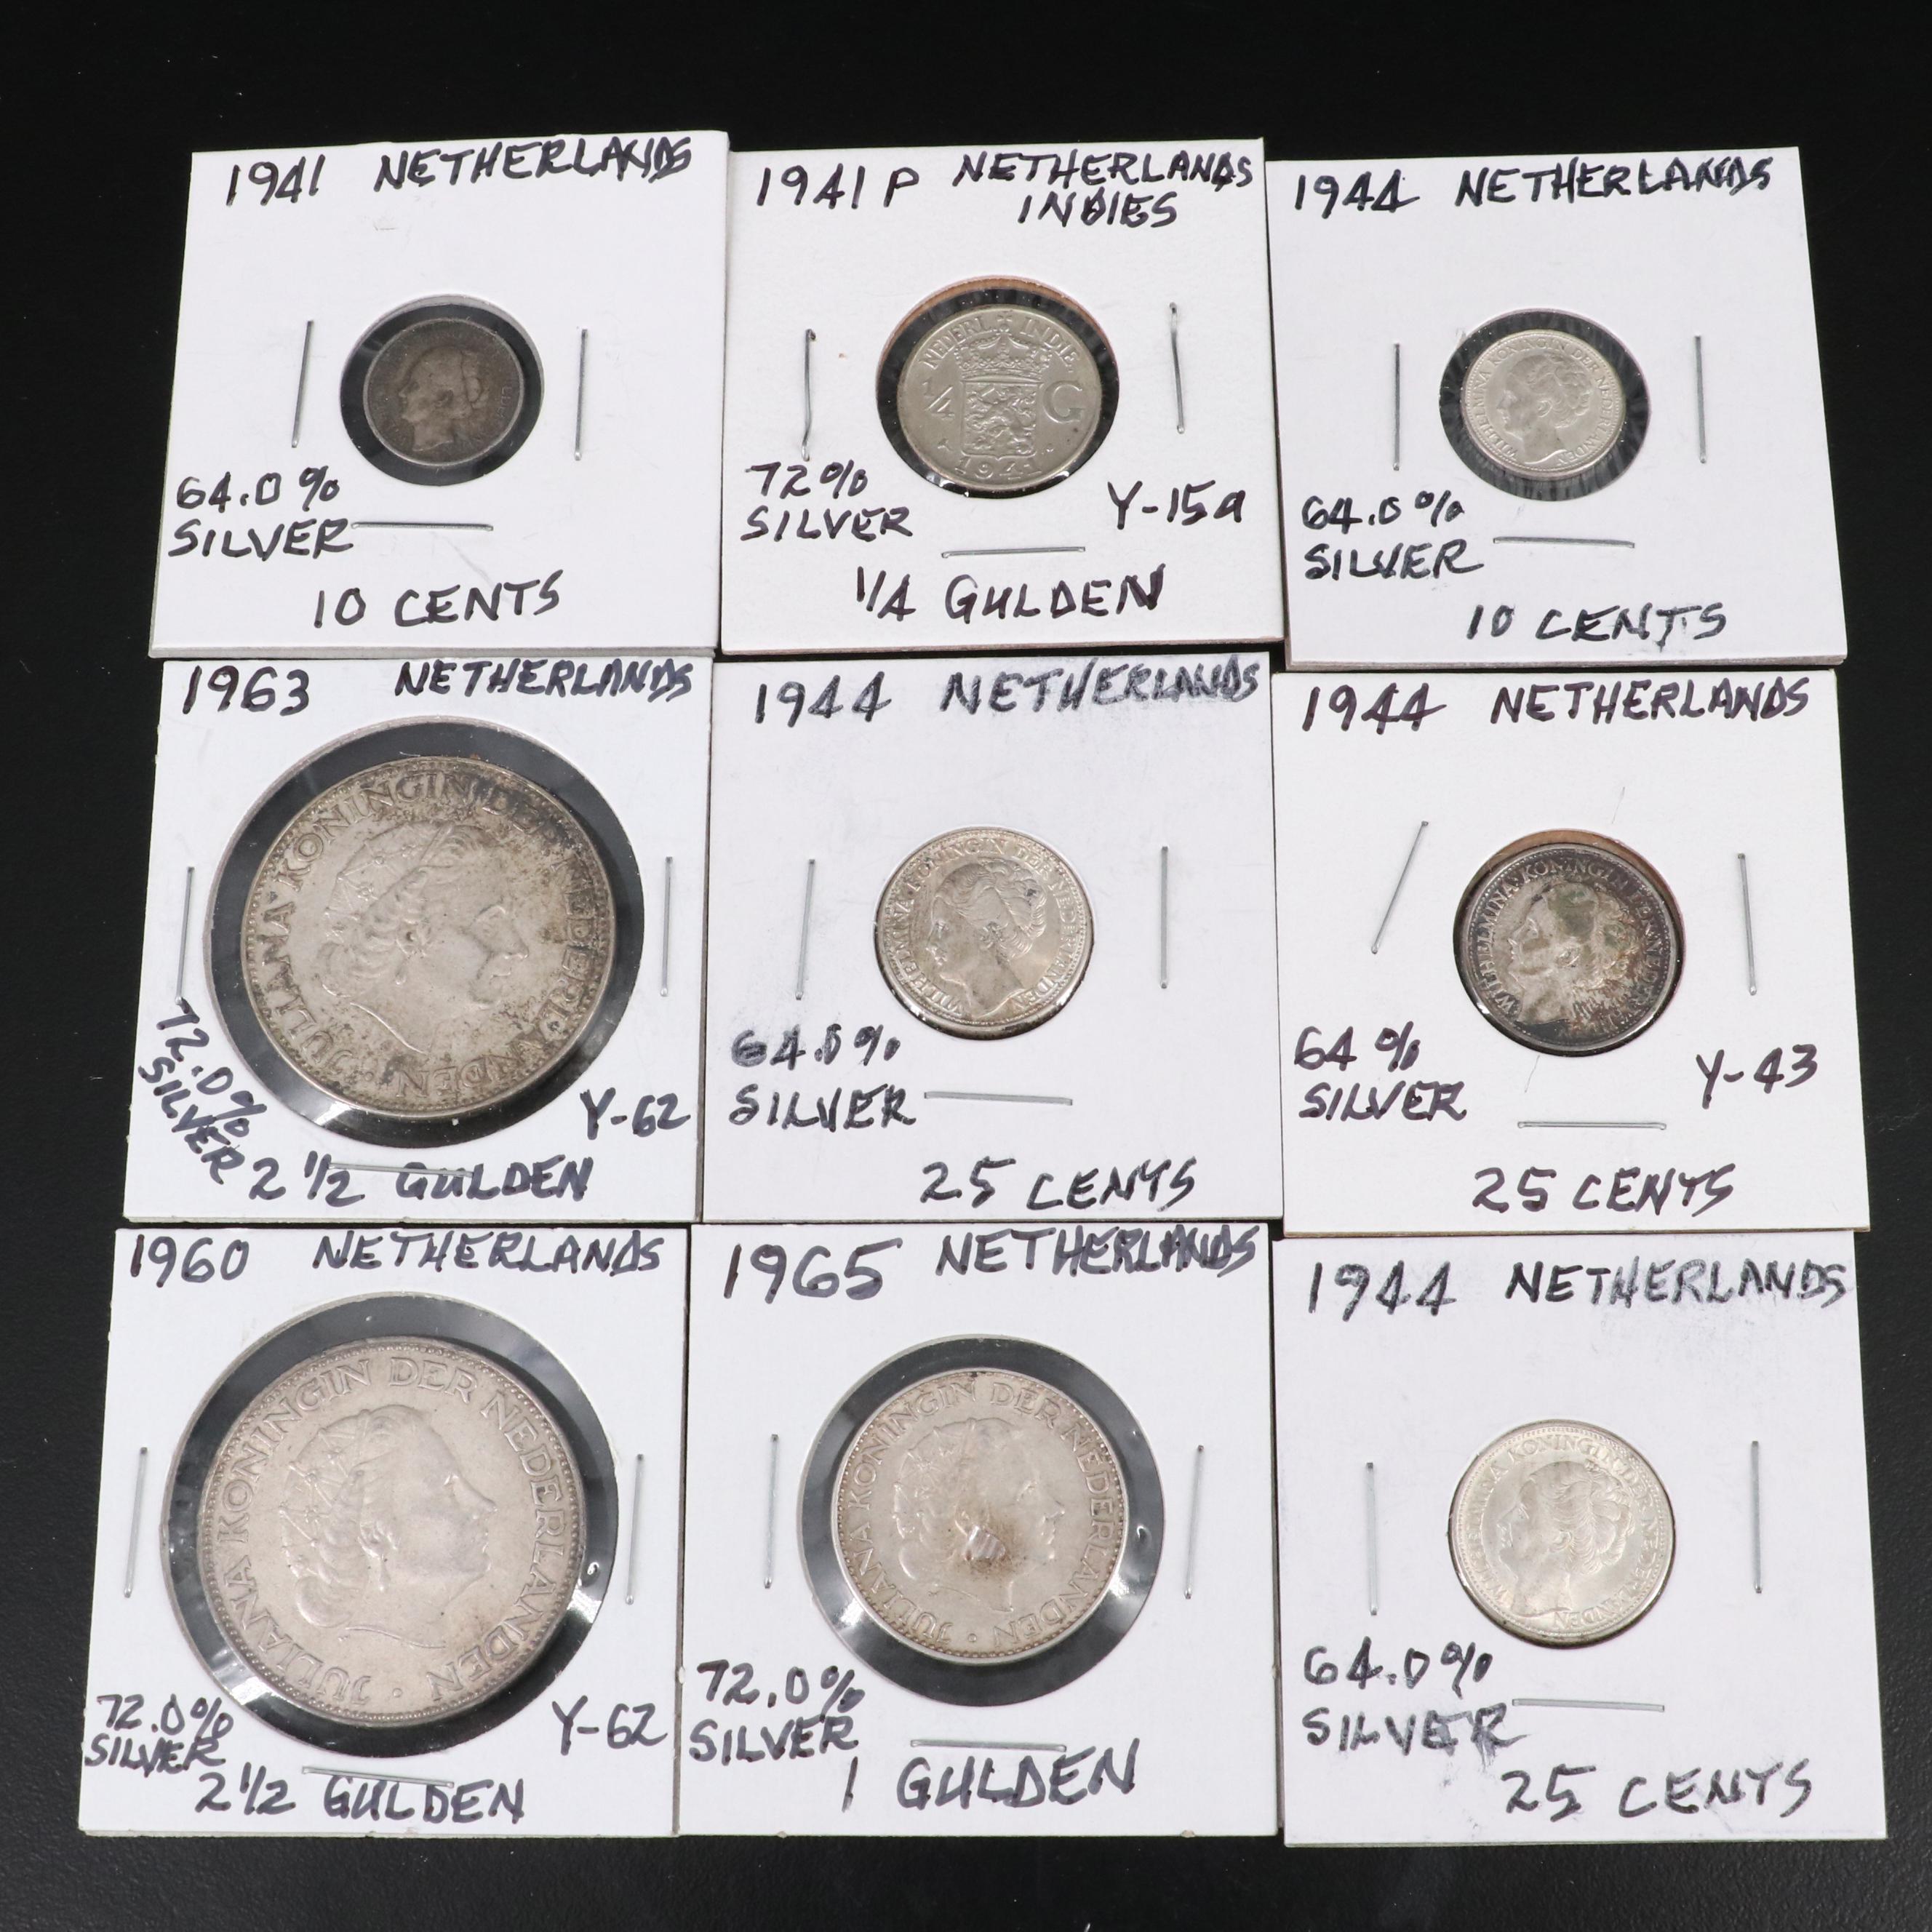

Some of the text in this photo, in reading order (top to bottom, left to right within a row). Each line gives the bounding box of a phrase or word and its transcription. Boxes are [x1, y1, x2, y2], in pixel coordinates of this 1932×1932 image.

[225, 136, 692, 206] 1941 NETHERLANDS
[757, 148, 1253, 209] 1941 P NETHERLANDS
[1294, 156, 1773, 220] 1944 NETHERLANDS
[1018, 186, 1178, 228] INDIES
[1571, 350, 1600, 375] DER
[1043, 380, 1085, 424] G
[750, 460, 868, 500] 72%
[1107, 479, 1246, 530] Y-15a
[168, 518, 354, 562] SILVER
[741, 505, 913, 543] SILVER
[1304, 538, 1485, 581] SILVER
[314, 570, 563, 628] 10 CENTS
[857, 563, 1166, 624] 1/4 GULDEN
[1466, 602, 1726, 650] 10 CENTS
[182, 658, 693, 716] 1963 NETHERLANDS
[756, 659, 1260, 728] 1944 NETHERLANDS
[1302, 676, 1810, 735] 1944 NETHERLANDS
[276, 773, 474, 893] KONINGIN
[1298, 1080, 1467, 1122] SILVER
[1696, 1044, 1818, 1109] Y-43
[138, 1057, 246, 1185] SILVER
[580, 1087, 691, 1140] Y-62
[729, 1083, 917, 1133] SILVER
[250, 1151, 594, 1207] 2 1/2 GULDEN
[920, 1157, 1197, 1210] 25 CENTS
[1472, 1162, 1738, 1217] 25 CENTS
[130, 1229, 664, 1288] 1960 NETHERLANDS
[723, 1224, 1260, 1304] 1965 NETHERLANDS
[1308, 1259, 1846, 1322] 1944 NETHERLANDS
[217, 1357, 566, 1705] JULIANA KONINGIN DER NEDERLANDEN
[848, 1382, 1114, 1646] JULIANA KONINGIN DER NEDERLANDEN
[551, 1695, 666, 1756] Y-62
[690, 1713, 860, 1766] SILVER
[1301, 1702, 1517, 1757] SILVER
[84, 1734, 224, 1778] SILVER
[842, 1738, 1140, 1811] 1 GULDEN
[195, 1762, 524, 1824] 2 1/2 GULDEN
[1501, 1762, 1811, 1822] 25 CENTS
